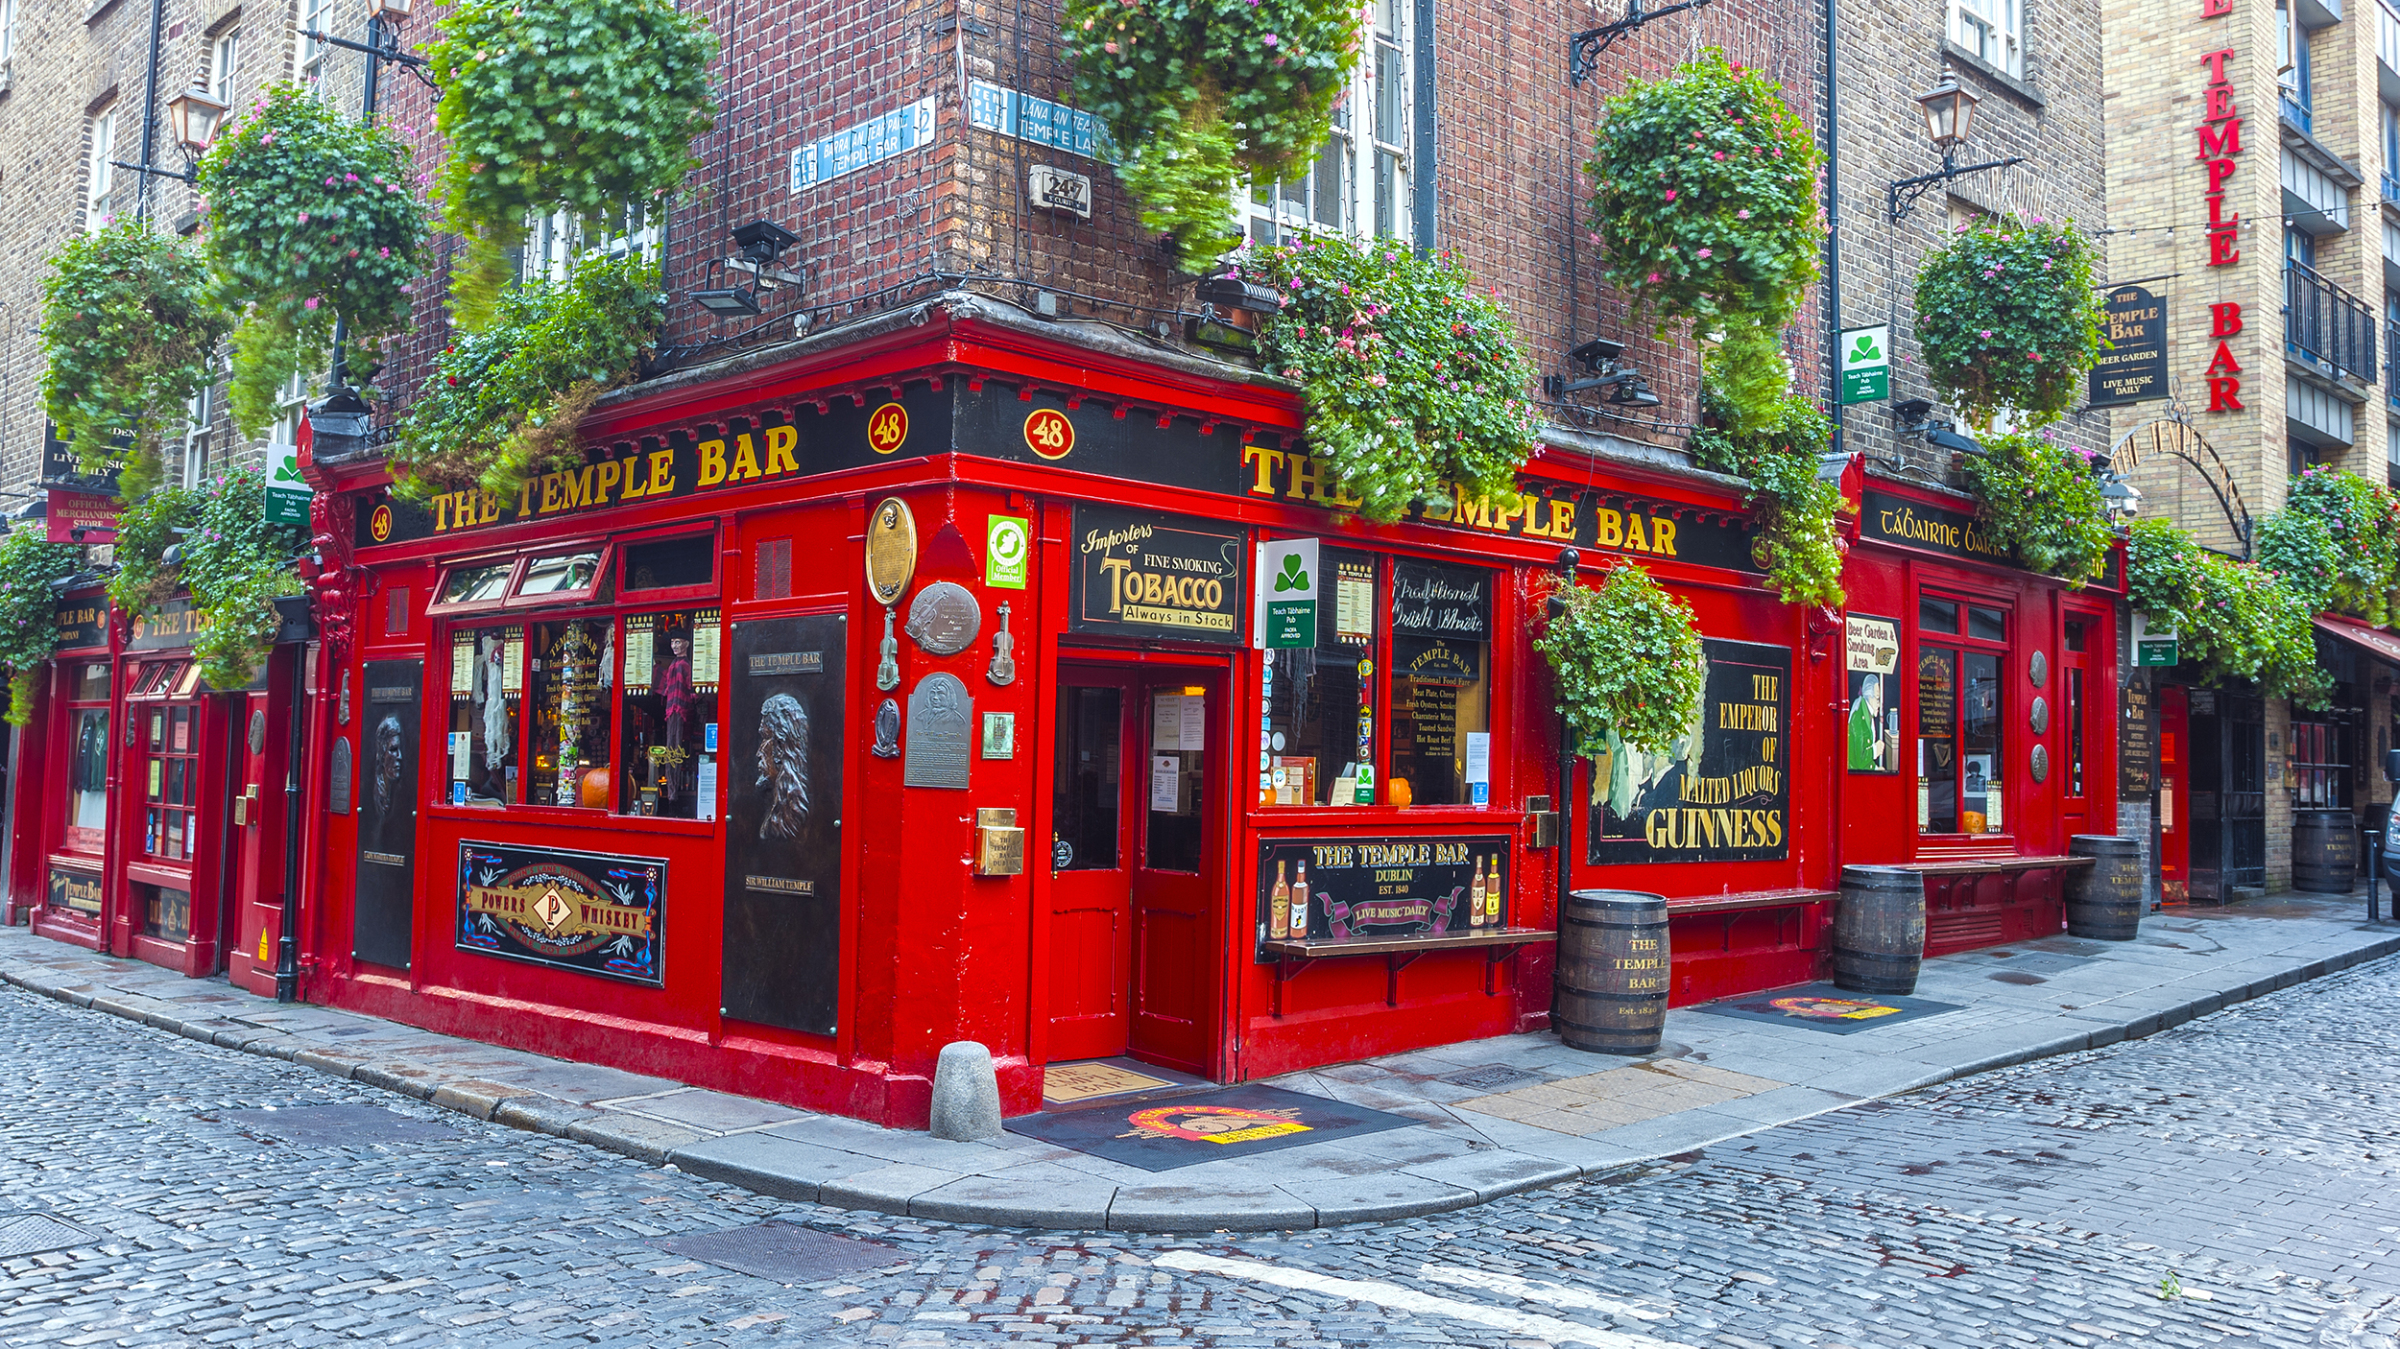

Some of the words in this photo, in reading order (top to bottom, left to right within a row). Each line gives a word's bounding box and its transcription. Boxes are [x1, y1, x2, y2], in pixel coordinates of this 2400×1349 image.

[1053, 110, 1069, 126] AN
[852, 131, 864, 146] AN
[921, 111, 930, 133] 2
[833, 147, 872, 171] TEMPLE
[875, 137, 898, 156] BAR
[2195, 48, 2243, 267] TEMPLE
[2116, 292, 2138, 303] THE
[2097, 307, 2159, 328] TEMPLE
[2110, 322, 2144, 341] BAR
[2098, 353, 2123, 366] BEER
[2125, 350, 2158, 364] GARDEN
[2204, 302, 2245, 412] BAR
[2103, 378, 2123, 390] LIVE
[2125, 375, 2153, 388] MUSIC
[2116, 384, 2141, 395] DAILY
[874, 414, 901, 446] 48
[1034, 416, 1063, 448] 48
[72, 464, 110, 477] DILY
[431, 484, 502, 533] THE
[517, 447, 676, 517] TEMPLE
[698, 424, 800, 489] BAR
[68, 499, 109, 509] OFFICIAL
[56, 508, 121, 519] MERCHANDIS
[1402, 478, 1577, 541] EMPLE
[1597, 508, 1678, 559] BAR
[73, 519, 104, 528] STORE
[373, 511, 389, 537] 48
[1081, 523, 1152, 556] Importers
[1126, 544, 1139, 555] OF
[996, 565, 1018, 574] Official
[1144, 554, 1170, 569] FINE
[1172, 557, 1223, 575] SMOKING
[994, 572, 1020, 581] Member
[1100, 556, 1223, 613] TOBACCO
[77, 608, 95, 624] BAR
[153, 612, 180, 636] THE
[1125, 605, 1172, 623] Always
[1179, 611, 1190, 623] in
[1195, 611, 1231, 628] Stock
[1848, 621, 1863, 637] Beer
[1864, 624, 1888, 640] Garden
[1890, 629, 1895, 641] &
[582, 633, 597, 655] BAR
[1848, 638, 1875, 656] Smoking
[750, 656, 766, 667] THE
[768, 654, 801, 666] TEMPLE
[802, 652, 821, 664] BAR
[1410, 648, 1450, 671] TEMPLE
[1452, 653, 1471, 676] BAR
[1853, 654, 1869, 669] Area
[1409, 674, 1441, 684] Traditional
[1443, 676, 1456, 685] Food
[1458, 677, 1471, 686] Fare
[1753, 674, 1778, 701] THE
[1413, 688, 1424, 697] Meat
[2127, 689, 2147, 705] TEMPLE
[1406, 699, 1419, 708] Fresh
[2132, 705, 2144, 719] BAR
[1719, 702, 1777, 733] EMPEROR
[1419, 723, 1436, 732] Toasted
[1417, 735, 1426, 743] Hot
[1427, 735, 1440, 743] Roast
[1441, 735, 1452, 744] Beef
[1762, 737, 1777, 762] OF
[1679, 773, 1730, 805] MALTED
[1732, 765, 1782, 799] LIQUORS
[1645, 807, 1782, 848] GUINNESS
[1313, 845, 1353, 868] THE
[1359, 844, 1431, 867] TEMPLE
[1435, 843, 1469, 866] BAR
[560, 867, 600, 893] DISTILLERY
[746, 877, 756, 885] SIR
[757, 878, 785, 888] WILLIAM
[786, 880, 812, 891] TEMPLE
[1375, 869, 1413, 882] DUBLIN
[65, 878, 87, 900] TEMPLE
[1379, 886, 1394, 895] EST.
[1395, 885, 1408, 894] 1840
[481, 891, 526, 914] POWERS
[580, 904, 638, 930] WHISKEY
[546, 894, 560, 922] P
[1355, 908, 1376, 919] LIVE
[1377, 906, 1403, 918] MUSIC
[1404, 905, 1428, 917] DAILY
[508, 926, 533, 948] PURE
[540, 944, 559, 954] POT
[567, 941, 596, 954] STILL
[1629, 939, 1658, 950] THE
[1613, 958, 1666, 970] TEMPLE
[1628, 977, 1656, 988] BAR
[1619, 1007, 1637, 1015] Est.
